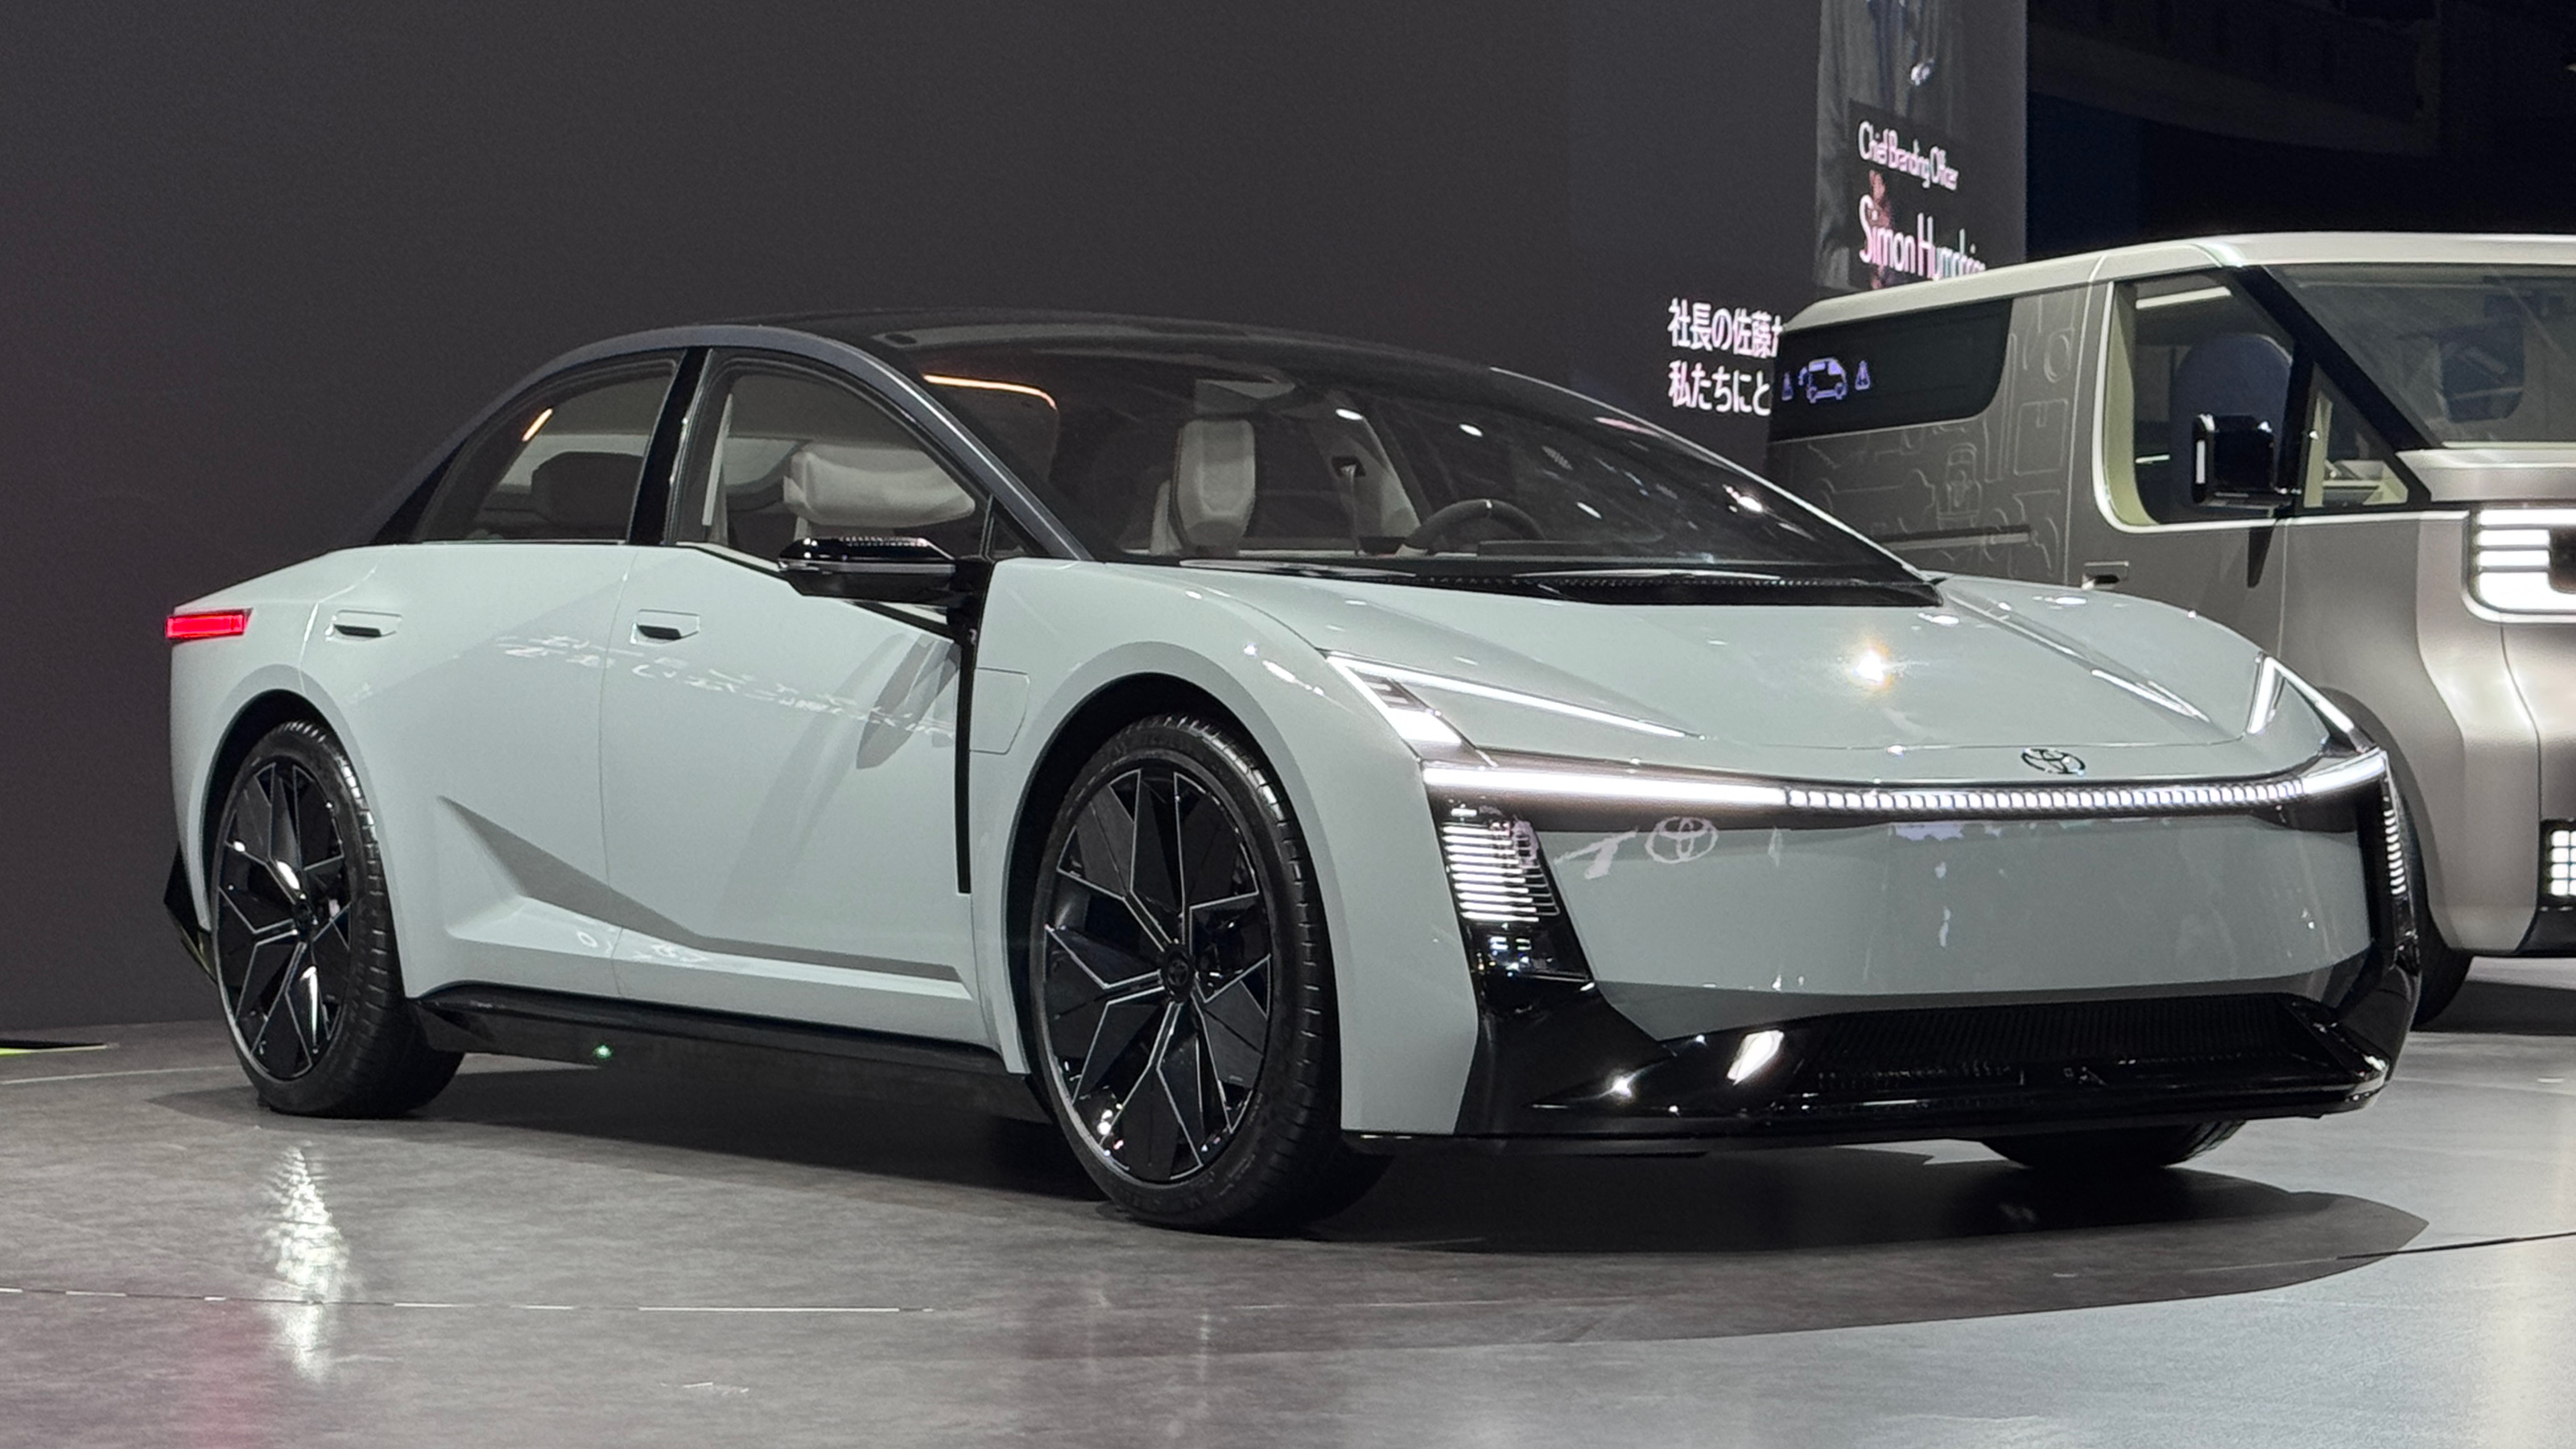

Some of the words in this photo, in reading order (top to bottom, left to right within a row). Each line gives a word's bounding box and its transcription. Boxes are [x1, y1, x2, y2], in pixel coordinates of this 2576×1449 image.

[1859, 194, 1916, 274] Simon
[1668, 360, 1772, 416] 私たちにと
